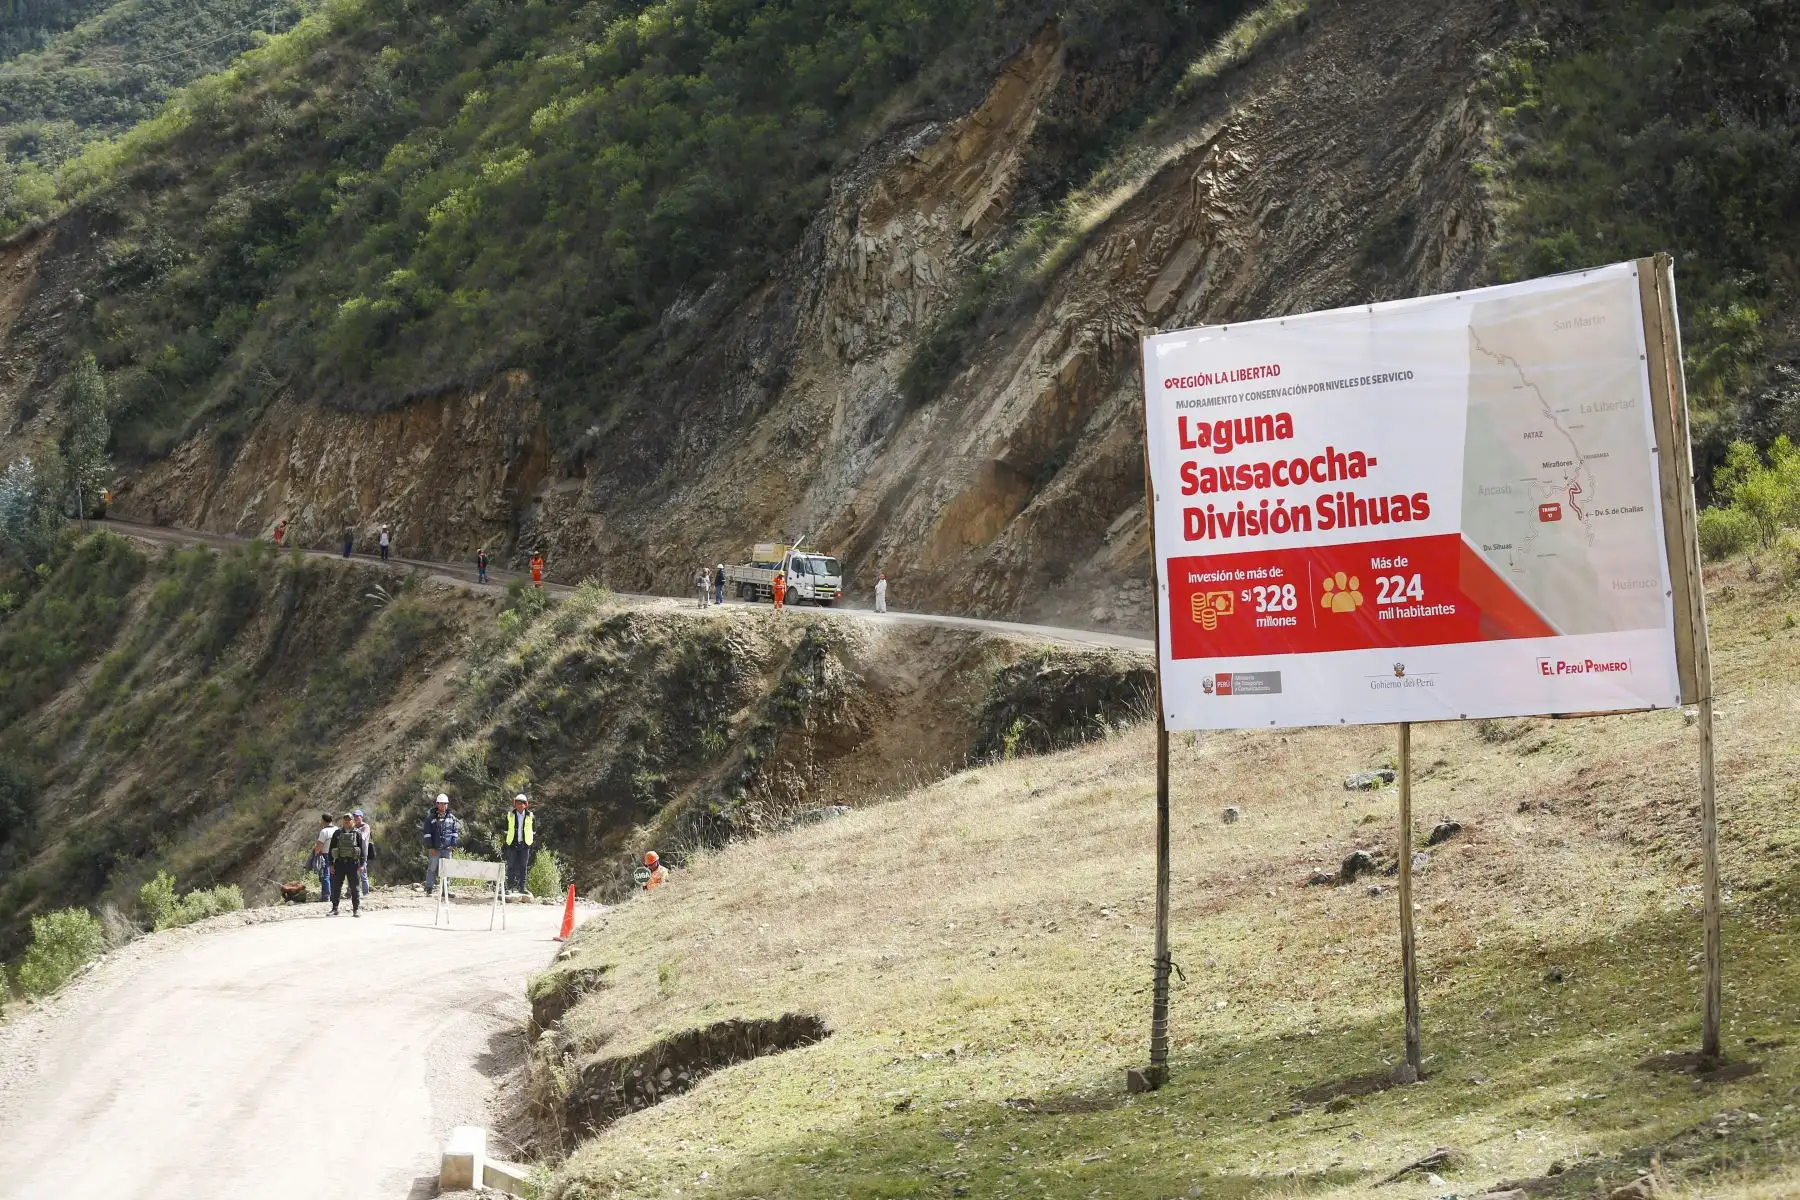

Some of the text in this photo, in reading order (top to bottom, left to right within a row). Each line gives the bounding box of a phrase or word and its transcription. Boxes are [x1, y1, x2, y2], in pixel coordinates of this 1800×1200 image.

[1215, 371, 1228, 384] LA
[1230, 364, 1281, 382] LIBERTAD
[1238, 393, 1245, 403] Y
[1245, 383, 1308, 402] CONSERVACIÓN
[1308, 382, 1326, 393] POR
[1326, 377, 1359, 391] NIVELES
[1360, 375, 1371, 386] DE
[1371, 370, 1414, 385] SERVICIO
[1178, 411, 1294, 454] Laguna
[1523, 431, 1544, 440] PATAZ
[1180, 446, 1377, 496] Sausacocha-
[1542, 460, 1573, 469] Miraflores
[1183, 491, 1431, 542] División Sihuas
[1188, 565, 1284, 583] Inversión de más de:
[1371, 555, 1408, 569] Más de
[1253, 583, 1298, 613] 328
[1375, 573, 1424, 605] 224
[1379, 603, 1456, 620] mil habitantes
